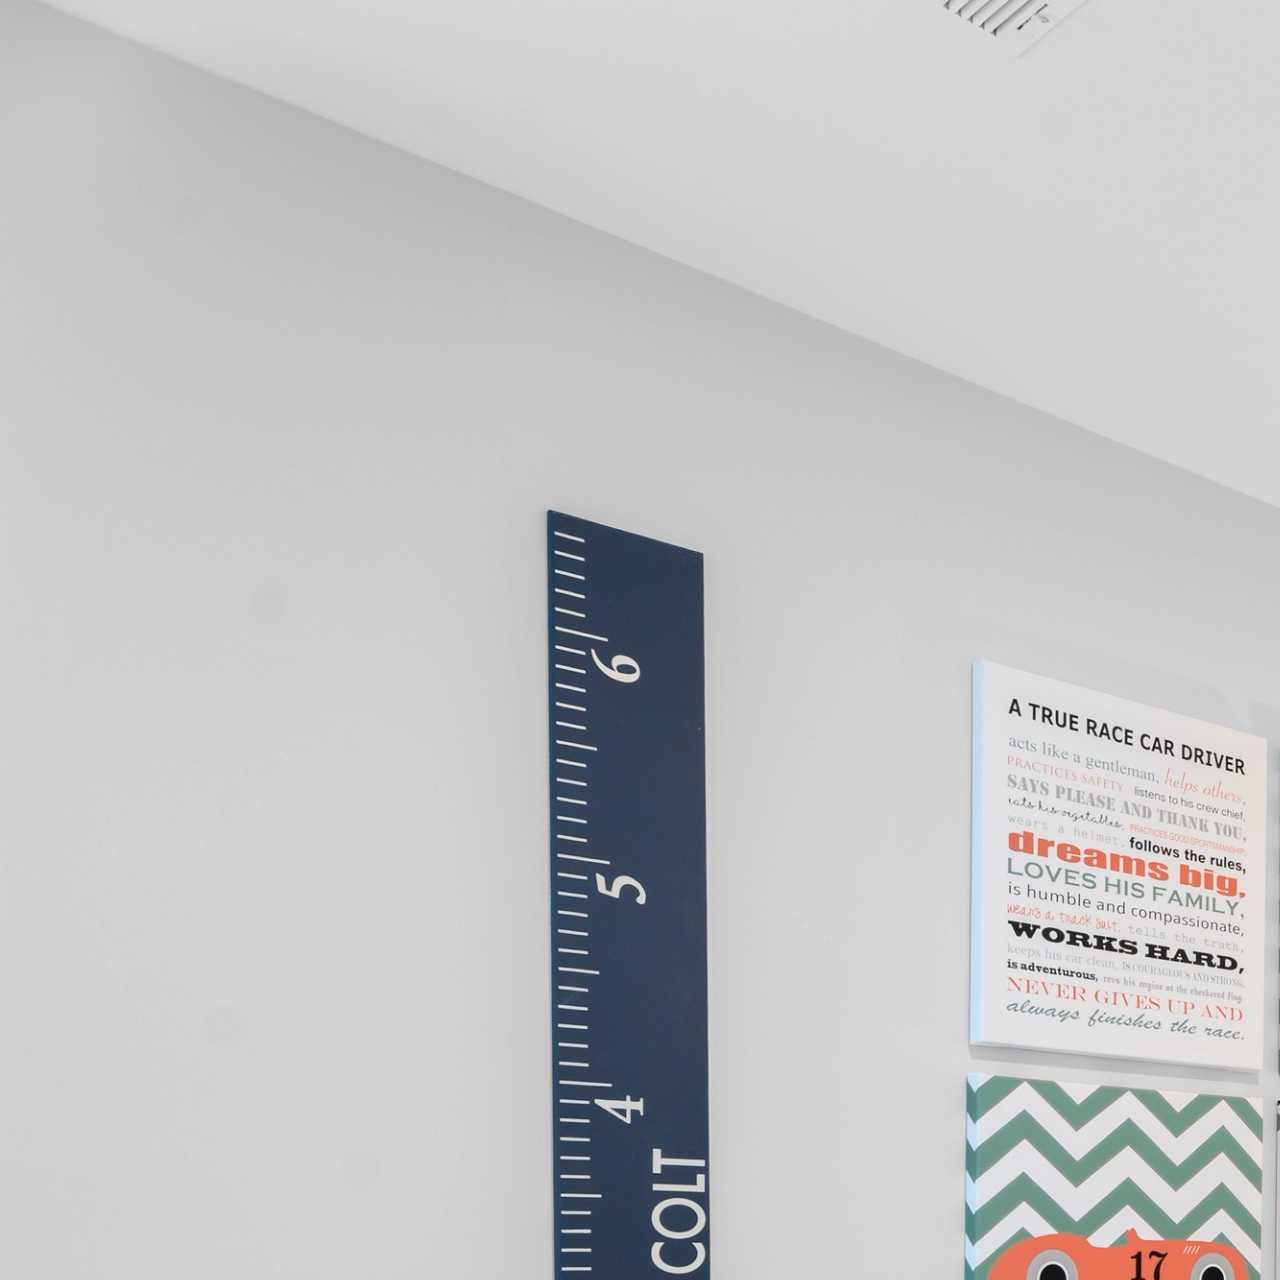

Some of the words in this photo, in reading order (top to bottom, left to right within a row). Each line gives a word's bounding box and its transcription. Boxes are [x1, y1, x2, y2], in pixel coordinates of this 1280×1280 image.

[591, 647, 641, 684] 6
[1008, 698, 1021, 717] A
[1028, 702, 1079, 732] TRUE
[1086, 718, 1134, 746] RACE
[1140, 733, 1175, 757] CAR
[1181, 744, 1245, 776] DRIVER
[1008, 736, 1037, 752] acts
[1042, 741, 1069, 760] like
[1073, 752, 1081, 763] a
[1085, 756, 1159, 784] gentleman,
[1164, 767, 1200, 794] helps
[1007, 774, 1049, 796] SAYS
[1056, 784, 1116, 812] PLEASE
[1119, 800, 1152, 819] AND
[1156, 807, 1209, 833] THANK
[1214, 821, 1247, 842] YOU,
[1008, 797, 1036, 809] eats
[1038, 799, 1060, 814] his
[1134, 786, 1166, 802] listens
[1168, 795, 1178, 805] to
[1181, 796, 1194, 809] his
[1196, 802, 1219, 815] crew
[1221, 808, 1246, 823] chief,
[1008, 815, 1048, 830] wears
[1129, 837, 1180, 858] follows
[1185, 849, 1206, 864] the
[1210, 856, 1246, 875] rules,
[1009, 831, 1168, 881] dreams
[595, 873, 646, 905] 5
[1008, 857, 1097, 889] LOVES
[1105, 876, 1145, 899] HIS
[1153, 886, 1244, 918] FAMILY,
[1008, 881, 1021, 896] is
[1027, 884, 1091, 909] humble
[1096, 901, 1126, 915] and
[1131, 905, 1245, 937] compassionate,
[1007, 904, 1041, 919] wears
[1059, 912, 1090, 926] track
[1128, 925, 1166, 940] tells
[1175, 933, 1196, 944] the
[1008, 920, 1138, 955] WORKS
[1145, 943, 1245, 975] HARD,
[1065, 954, 1082, 965] car
[1007, 958, 1018, 969] is
[1020, 961, 1098, 982] adventurous,
[1123, 977, 1136, 987] his
[1006, 1000, 1080, 1023] always
[1087, 1009, 1162, 1030] finishes
[1170, 1018, 1197, 1034] the
[1204, 1026, 1245, 1041] race.
[1007, 976, 1086, 1001] NEVER
[1093, 989, 1160, 1010] GIVES
[1168, 999, 1195, 1016] UP
[1201, 1004, 1244, 1021] AND
[595, 1095, 644, 1124] 4
[651, 1148, 706, 1274] COLT
